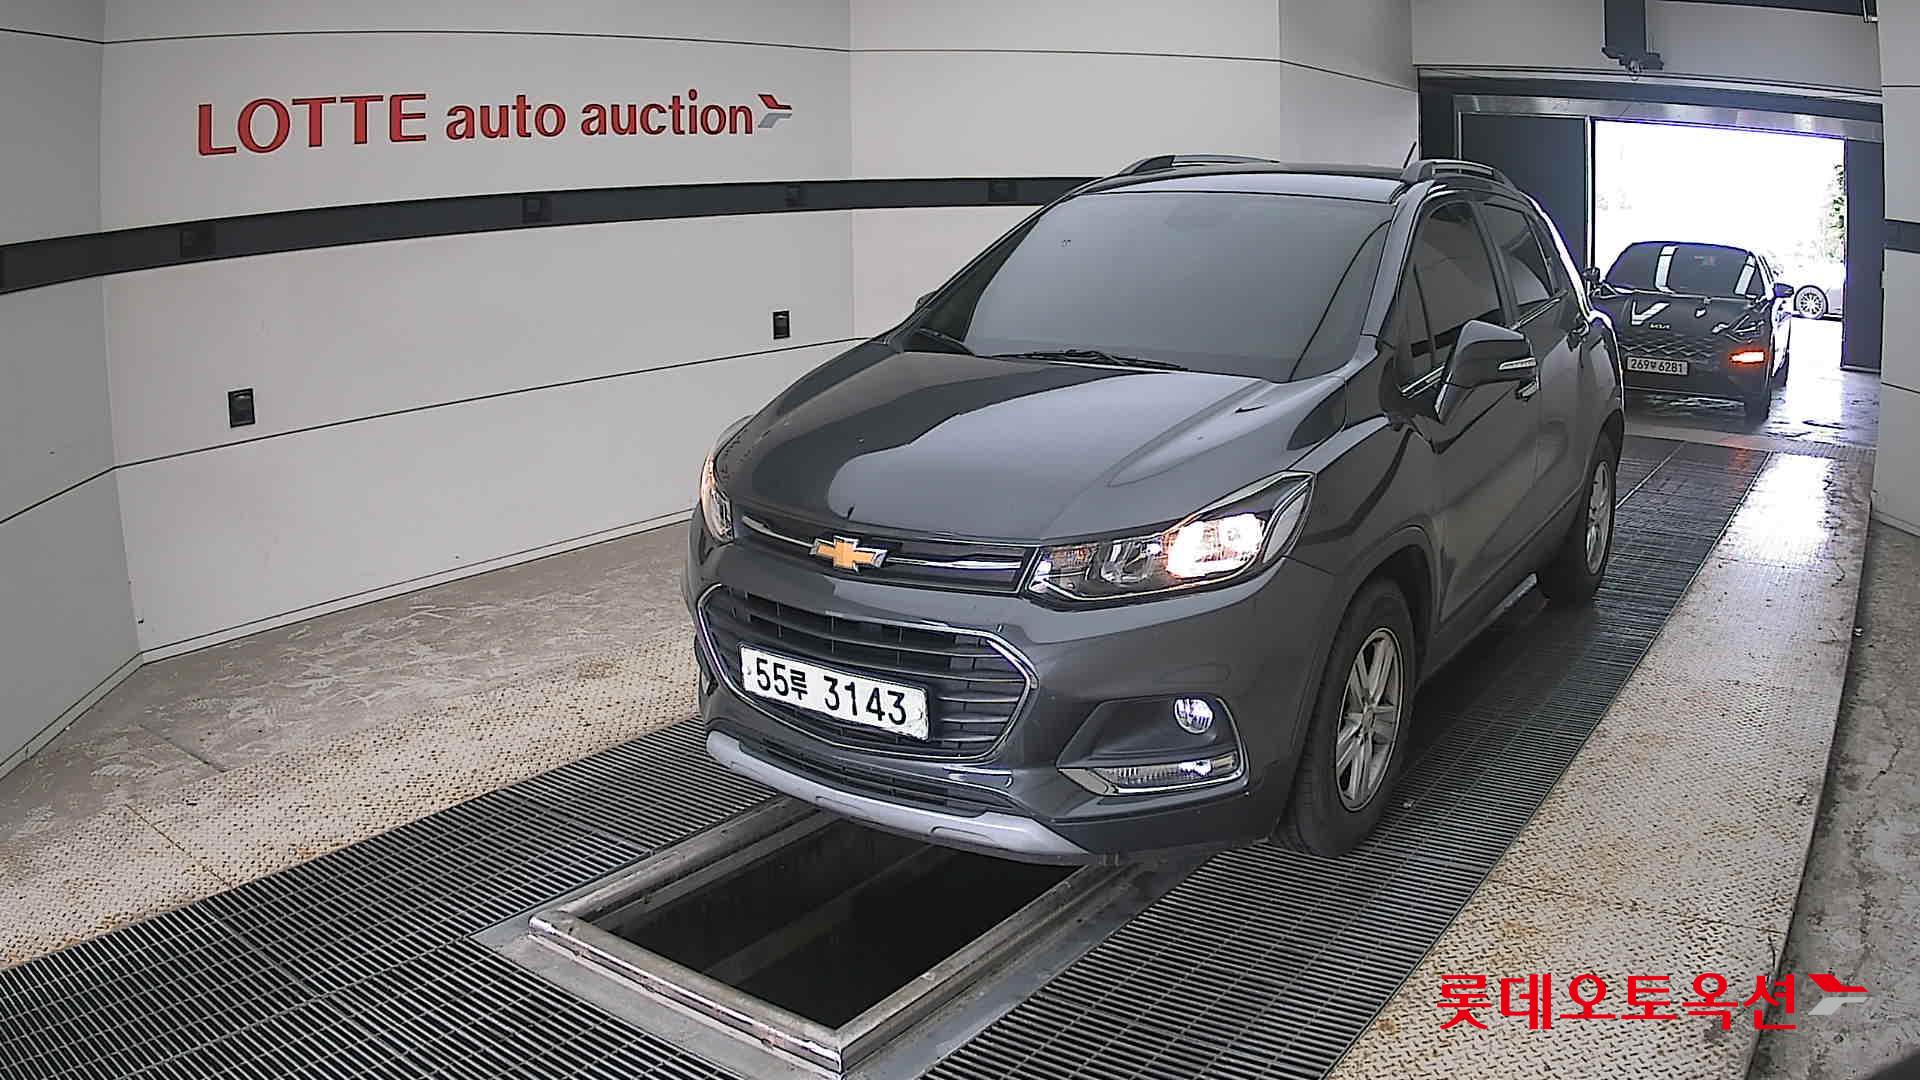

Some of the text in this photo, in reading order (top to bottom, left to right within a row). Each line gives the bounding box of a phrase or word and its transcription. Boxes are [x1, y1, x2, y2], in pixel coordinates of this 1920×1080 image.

[197, 88, 754, 156] LOTTE auto auction
[756, 657, 907, 725] 55루 3143
